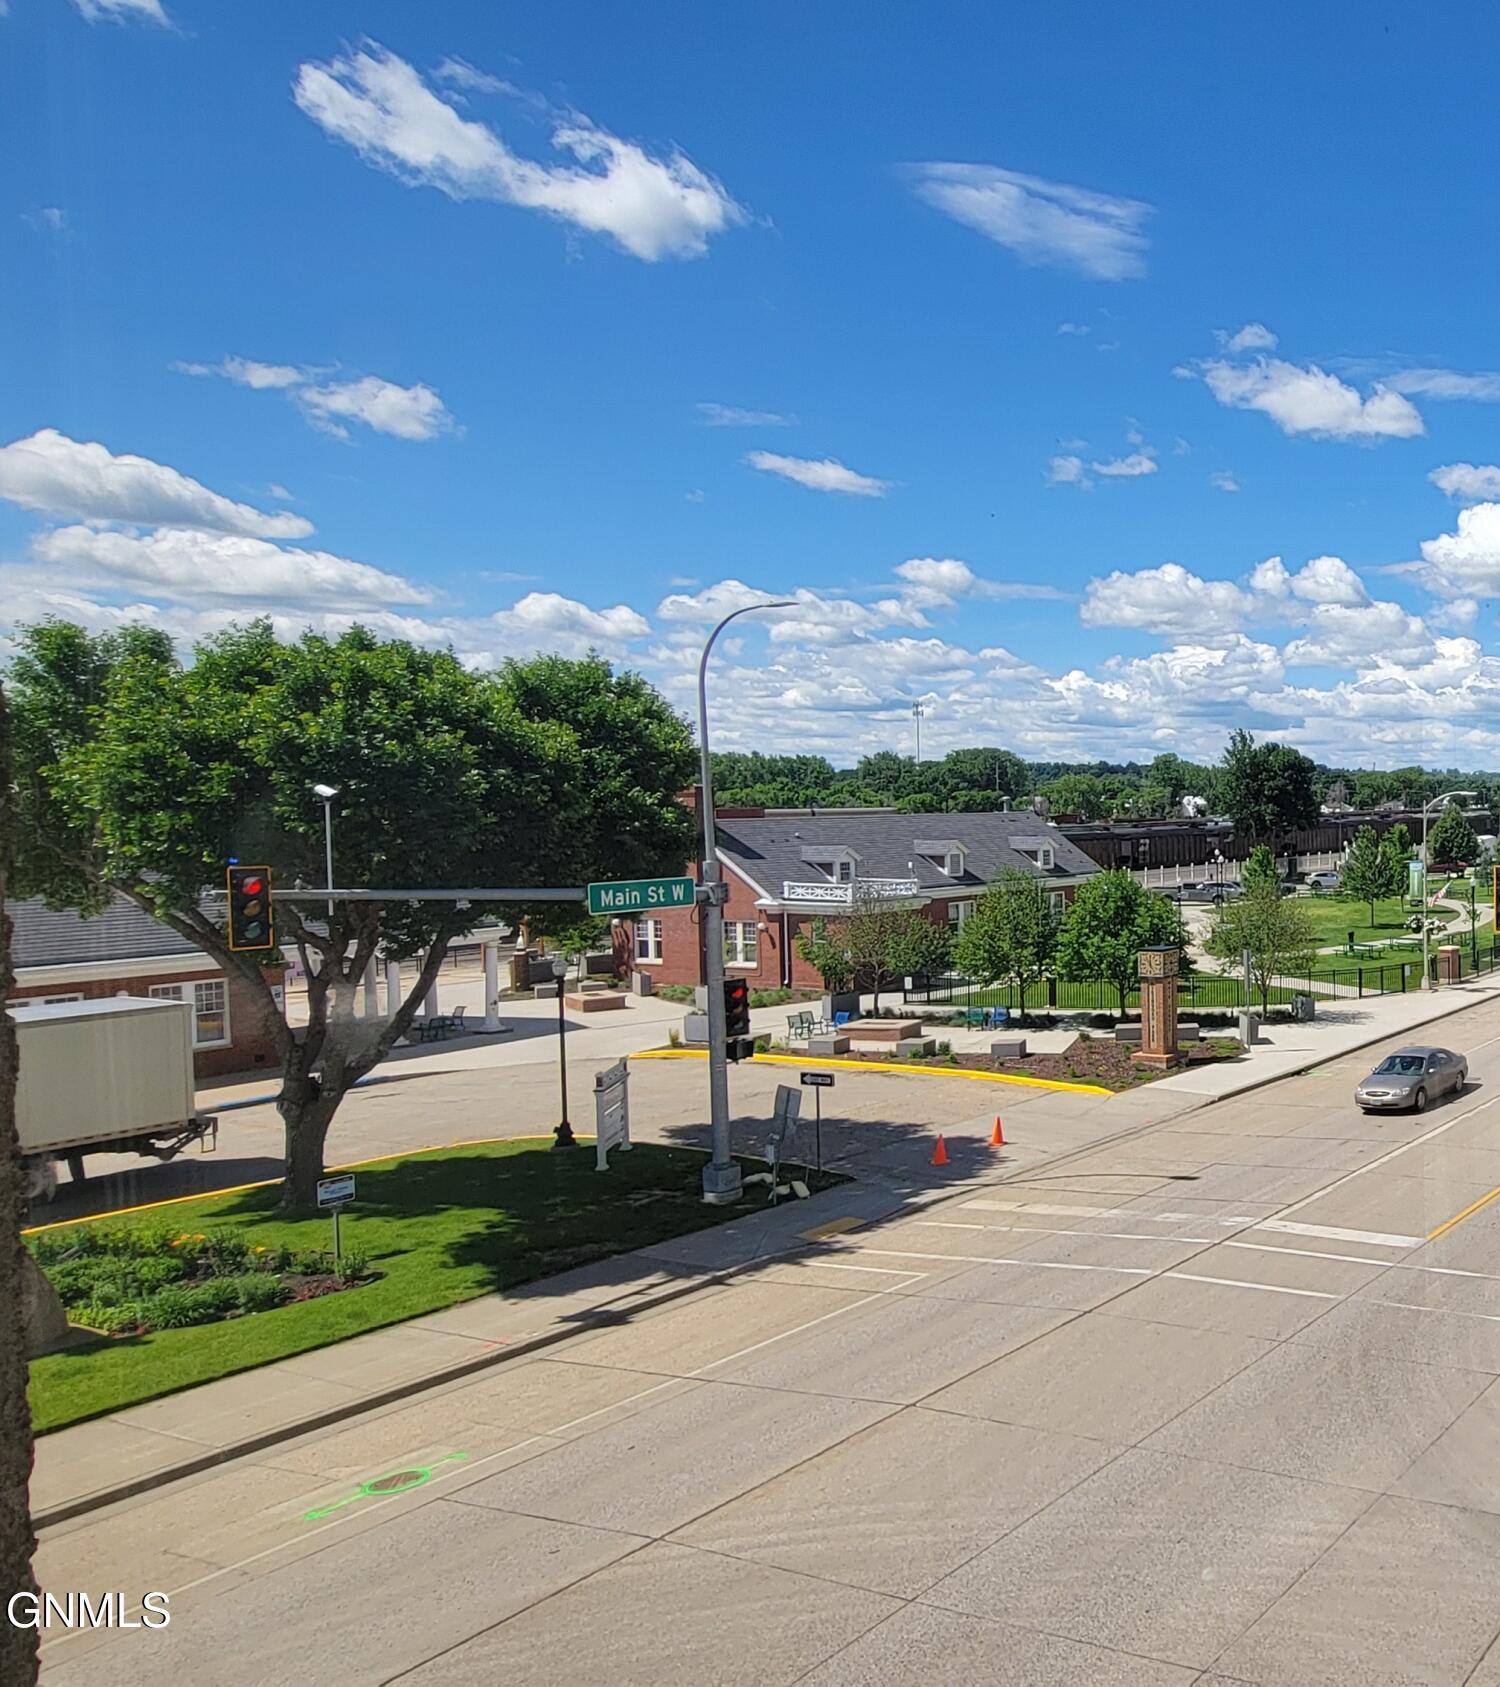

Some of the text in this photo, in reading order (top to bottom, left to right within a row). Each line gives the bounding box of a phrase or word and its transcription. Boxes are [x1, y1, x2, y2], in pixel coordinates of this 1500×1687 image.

[600, 884, 685, 907] Main St W
